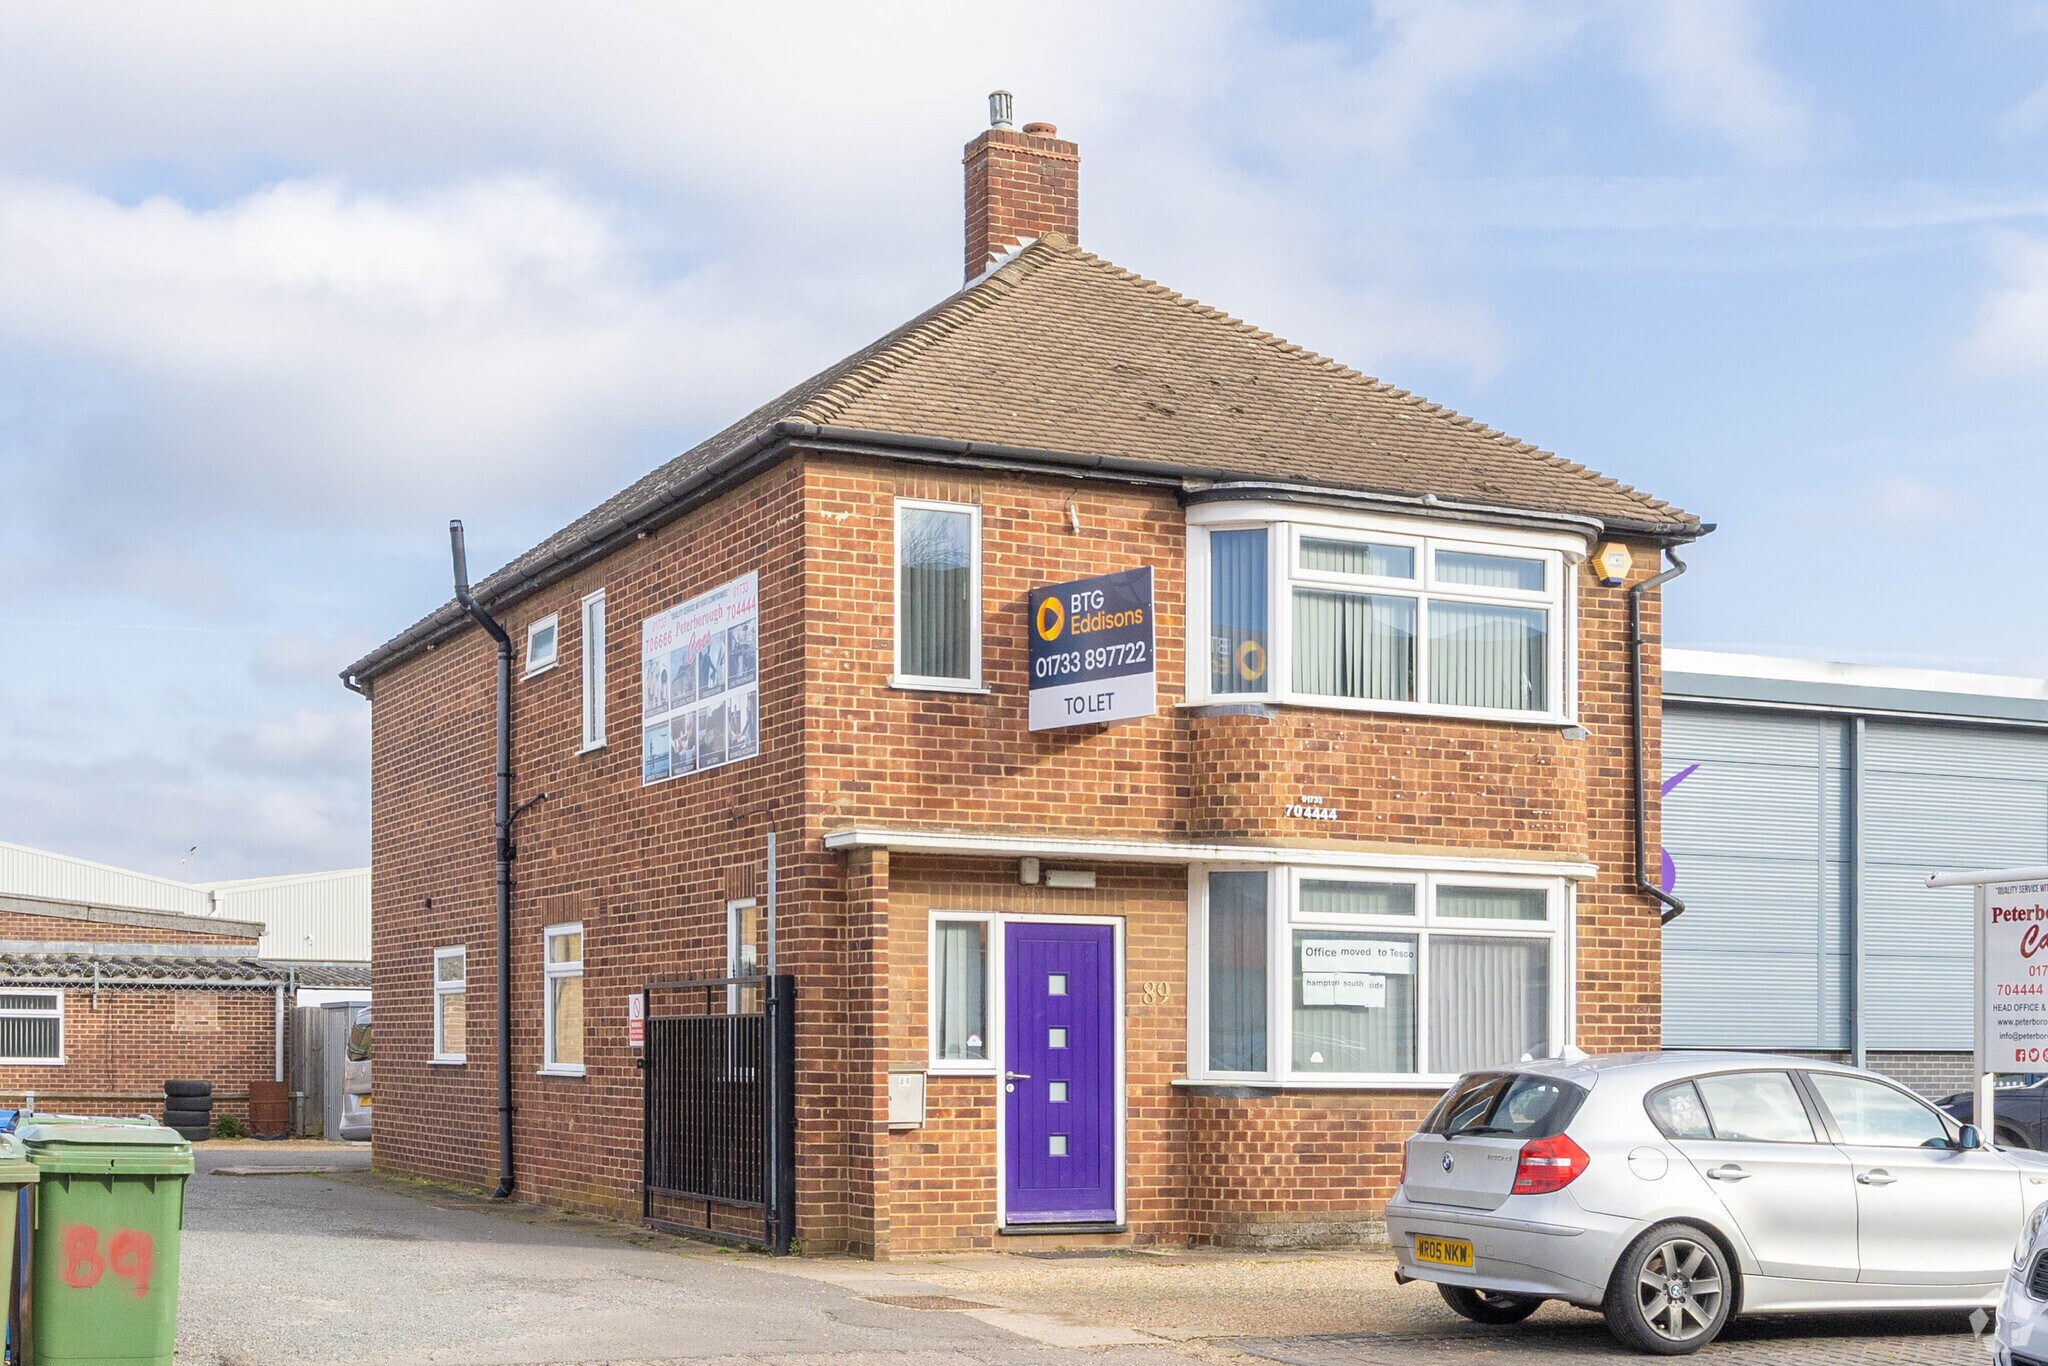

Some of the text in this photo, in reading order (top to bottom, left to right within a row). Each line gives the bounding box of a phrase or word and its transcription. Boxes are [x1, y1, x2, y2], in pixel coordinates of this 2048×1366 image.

[727, 595, 757, 621] 704444
[1071, 590, 1104, 614] BTG
[675, 603, 724, 637] Peterborough
[1071, 607, 1143, 635] Eddisons
[645, 630, 673, 655] 706666
[1035, 641, 1147, 678] 01733 897722
[1064, 692, 1115, 715] TO LET
[1285, 804, 1338, 820] 704444
[2019, 884, 2039, 893] SERVICE
[1991, 904, 2048, 924] Peterb
[1305, 947, 1337, 957] Office
[1340, 948, 1371, 956] moved
[1390, 948, 1414, 958] Tesco
[2029, 965, 2048, 977] 017
[1142, 980, 1171, 1006] 89
[1306, 979, 1340, 987] hampton
[1997, 984, 2044, 996] 704444
[900, 1077, 910, 1085] 89
[1419, 1240, 1467, 1262] WR05 NKW
